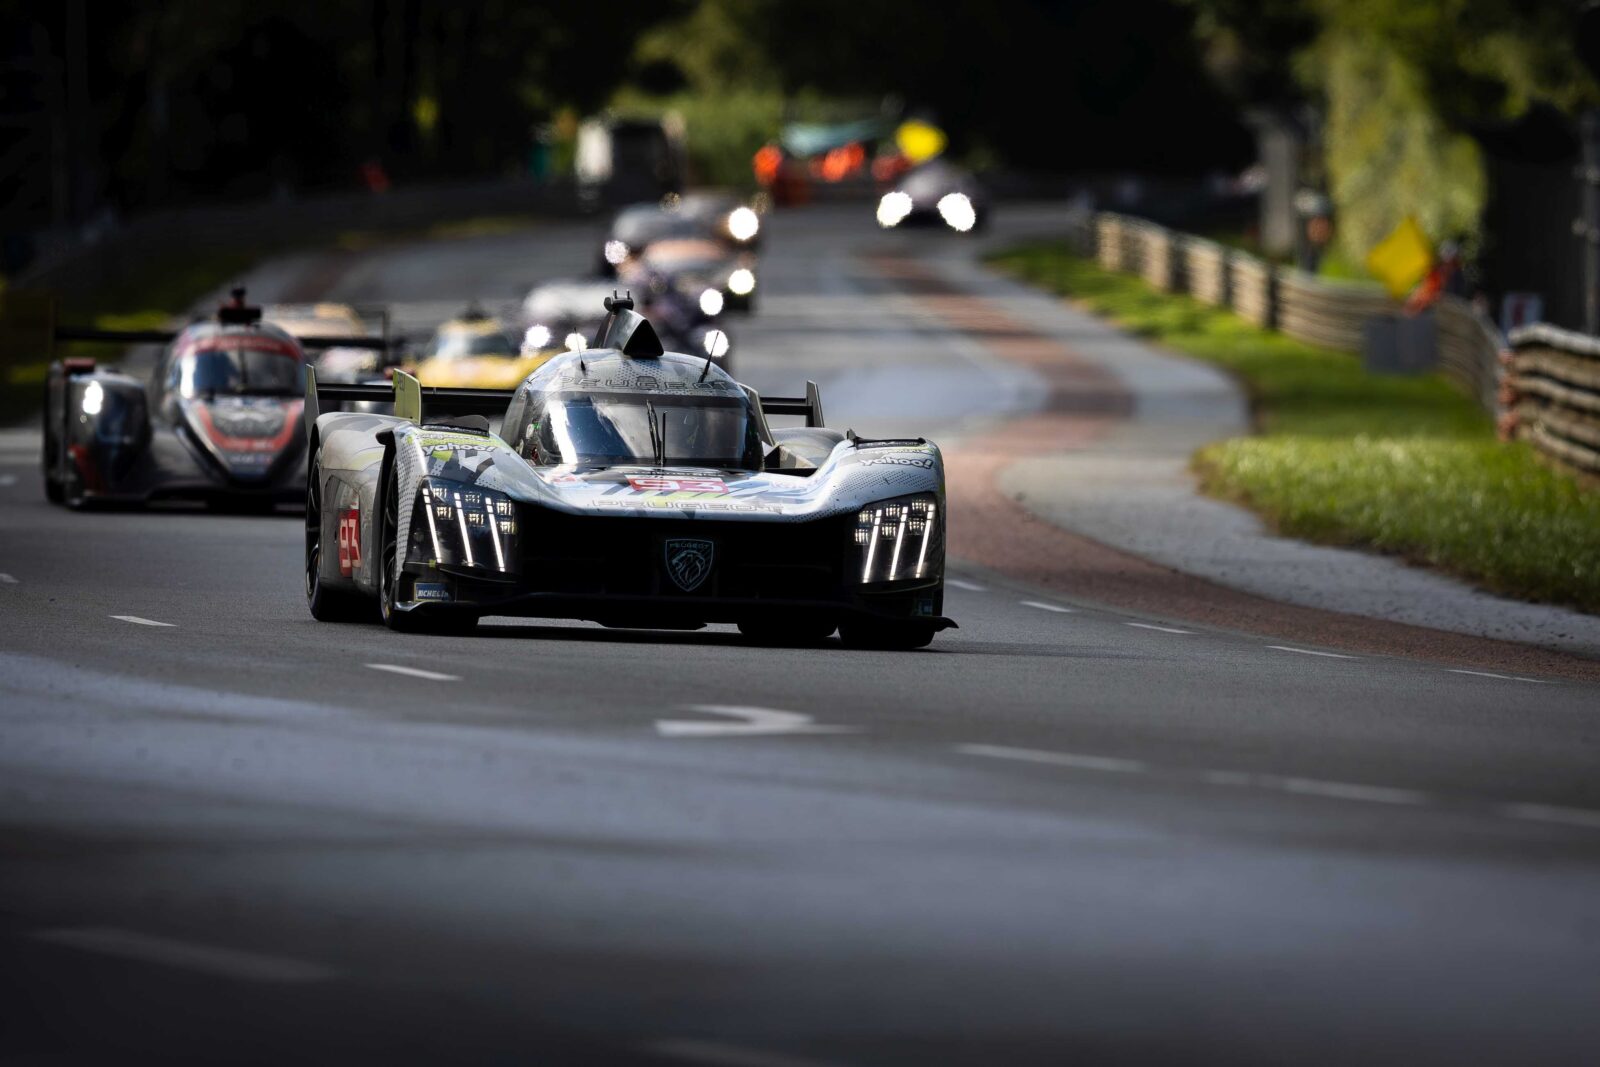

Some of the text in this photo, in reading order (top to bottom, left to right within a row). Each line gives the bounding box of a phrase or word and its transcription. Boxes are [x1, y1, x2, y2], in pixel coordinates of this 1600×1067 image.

[560, 376, 728, 390] PEUGEOT
[423, 443, 496, 456] yahoo!
[861, 456, 934, 470] yahoo!
[634, 479, 723, 492] 93
[591, 499, 783, 513] PEUGEOT
[340, 519, 361, 568] 93
